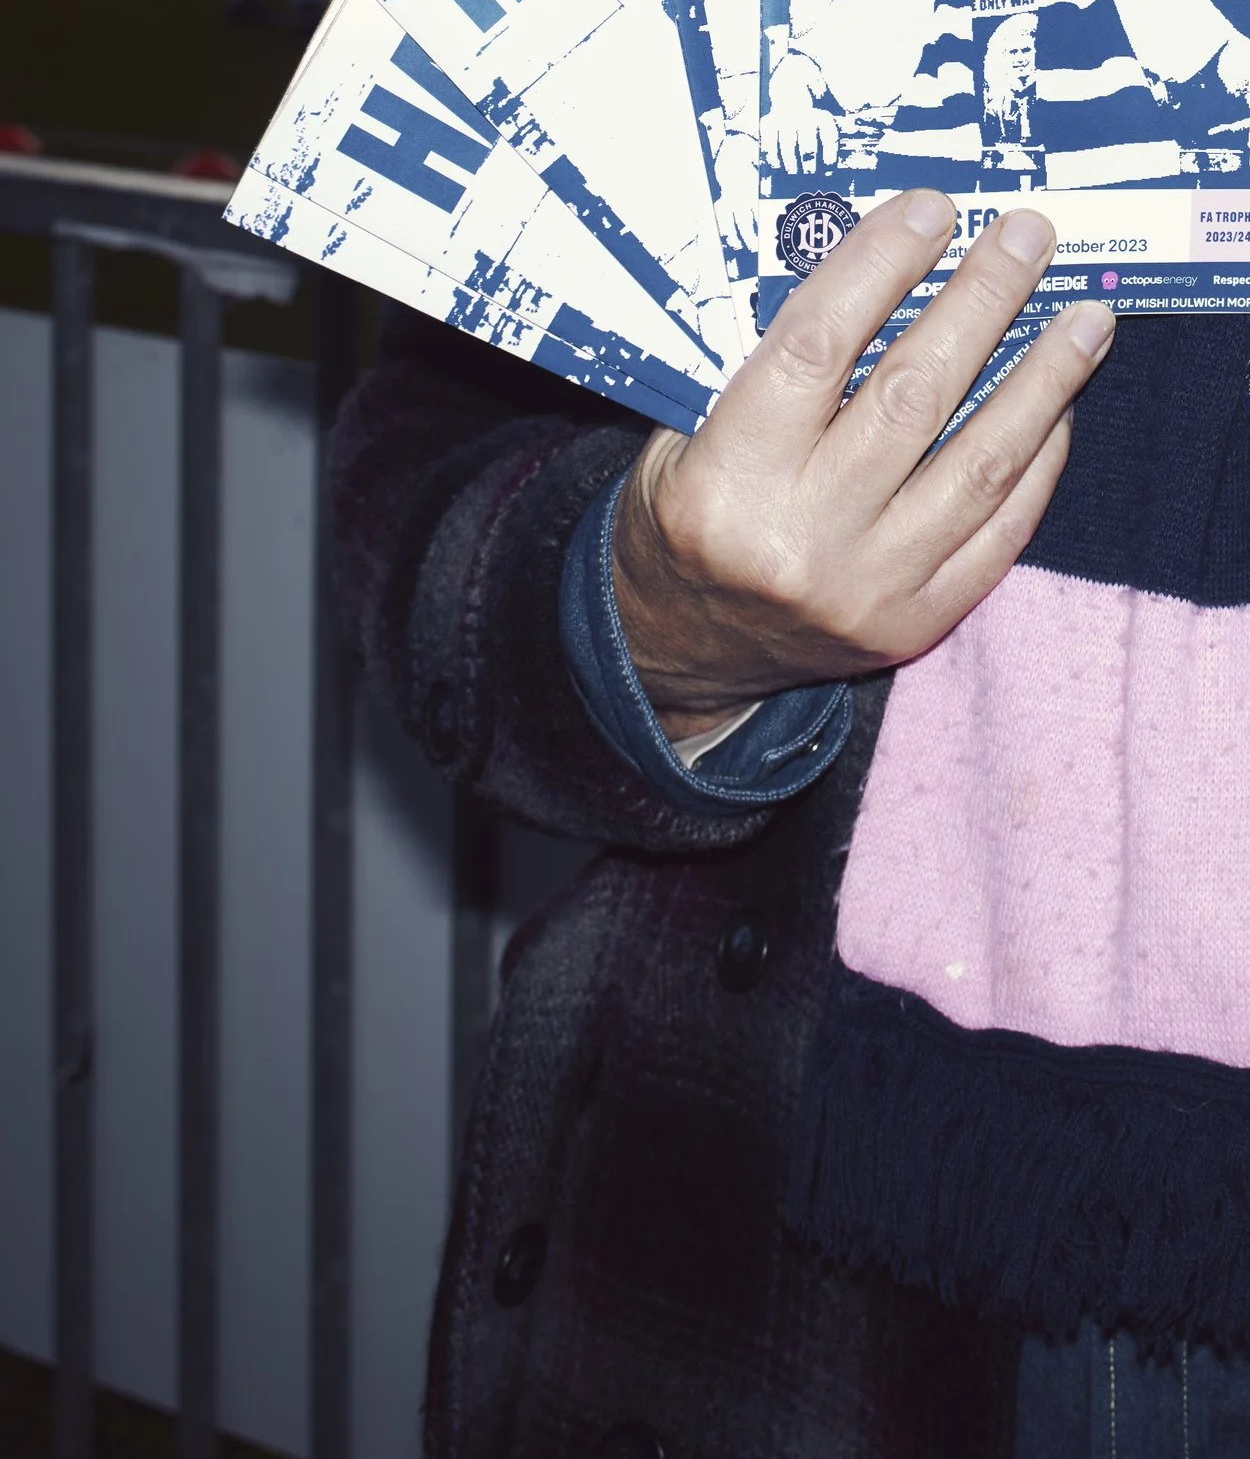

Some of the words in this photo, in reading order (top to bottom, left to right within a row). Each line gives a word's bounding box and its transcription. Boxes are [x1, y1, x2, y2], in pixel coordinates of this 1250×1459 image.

[783, 202, 812, 239] DULWICH
[815, 200, 849, 222] HAMLET
[1200, 211, 1213, 223] FA
[1056, 239, 1105, 254] ctober
[1108, 238, 1148, 252] 2023
[789, 251, 819, 271] FOUND
[1051, 301, 1063, 312] IN
[1117, 299, 1134, 309] OF
[1136, 298, 1168, 308] MISHI
[1171, 297, 1225, 308] DULWICH
[973, 380, 996, 402] THE
